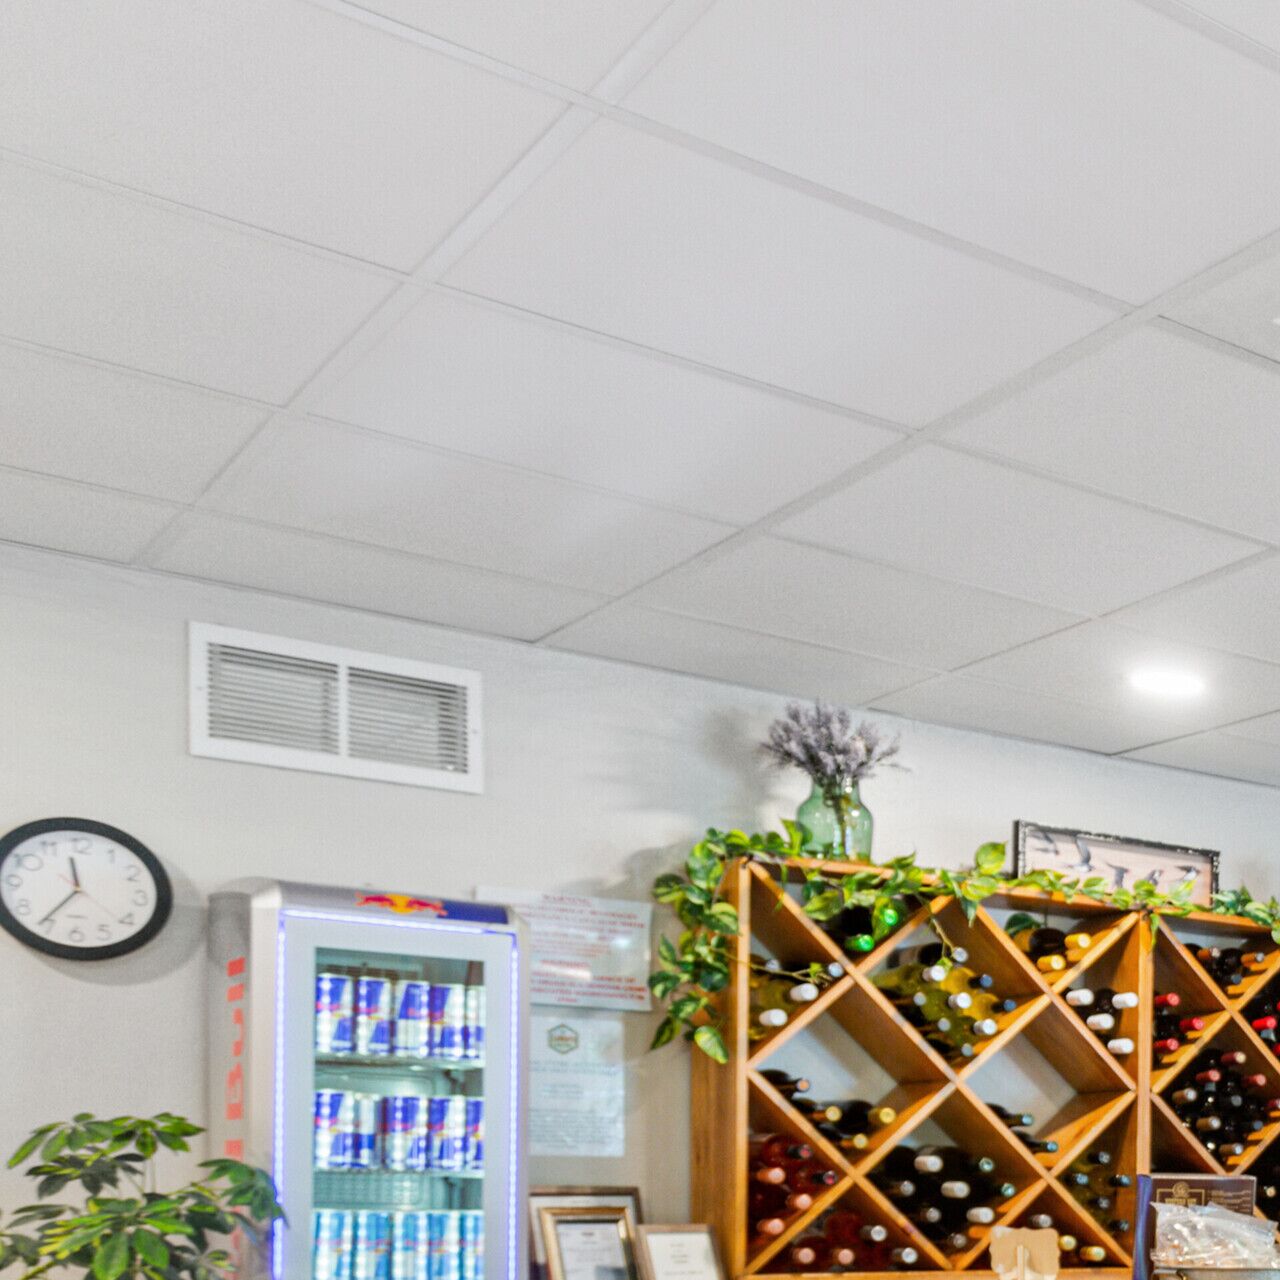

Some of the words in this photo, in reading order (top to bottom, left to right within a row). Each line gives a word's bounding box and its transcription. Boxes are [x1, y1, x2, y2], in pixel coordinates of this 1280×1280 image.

[40, 840, 57, 857] 11
[70, 836, 94, 856] 12
[14, 853, 44, 872] 10
[107, 849, 116, 864] 1
[6, 873, 23, 891] 9
[126, 864, 142, 882] 2
[16, 898, 32, 916] 8
[133, 889, 149, 907] 3
[117, 912, 135, 926] 4
[68, 928, 86, 943] 6
[98, 924, 112, 941] 5
